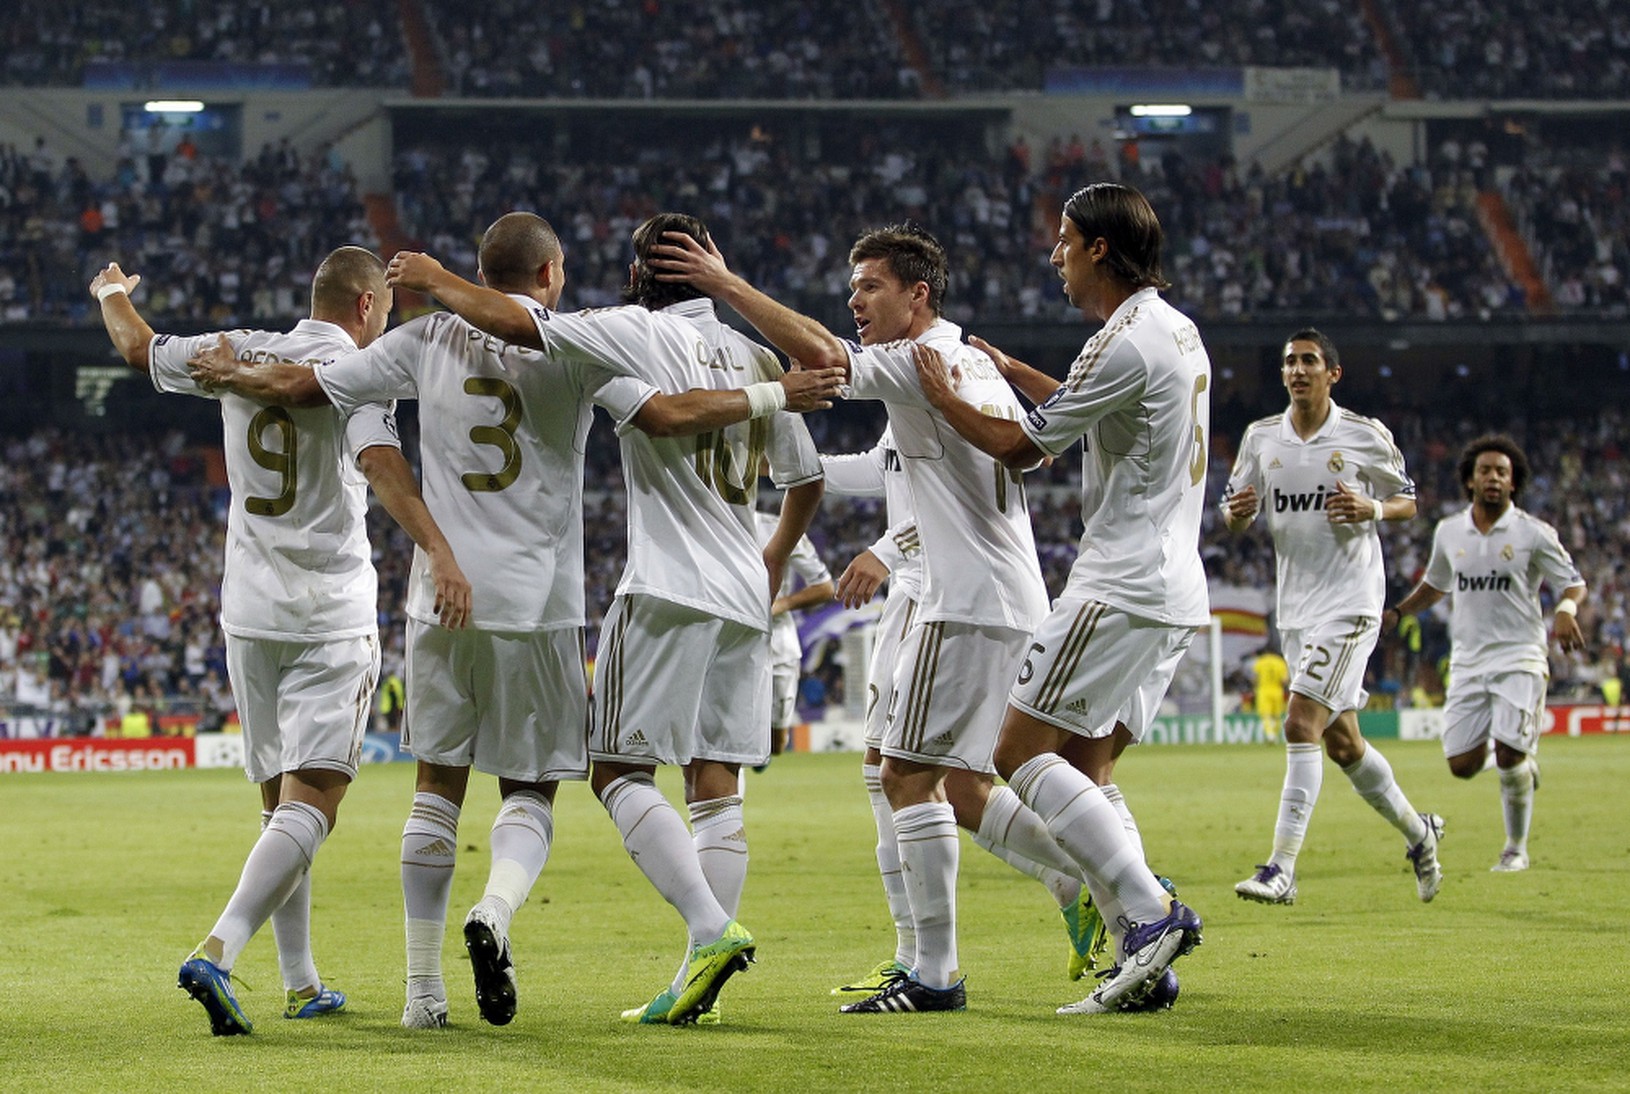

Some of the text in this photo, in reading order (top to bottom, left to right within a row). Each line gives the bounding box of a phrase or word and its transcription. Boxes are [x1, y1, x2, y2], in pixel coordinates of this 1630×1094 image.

[244, 405, 299, 517] 9
[461, 377, 523, 492] 3
[1458, 570, 1512, 592] bwin
[50, 745, 186, 772] Ericsson
